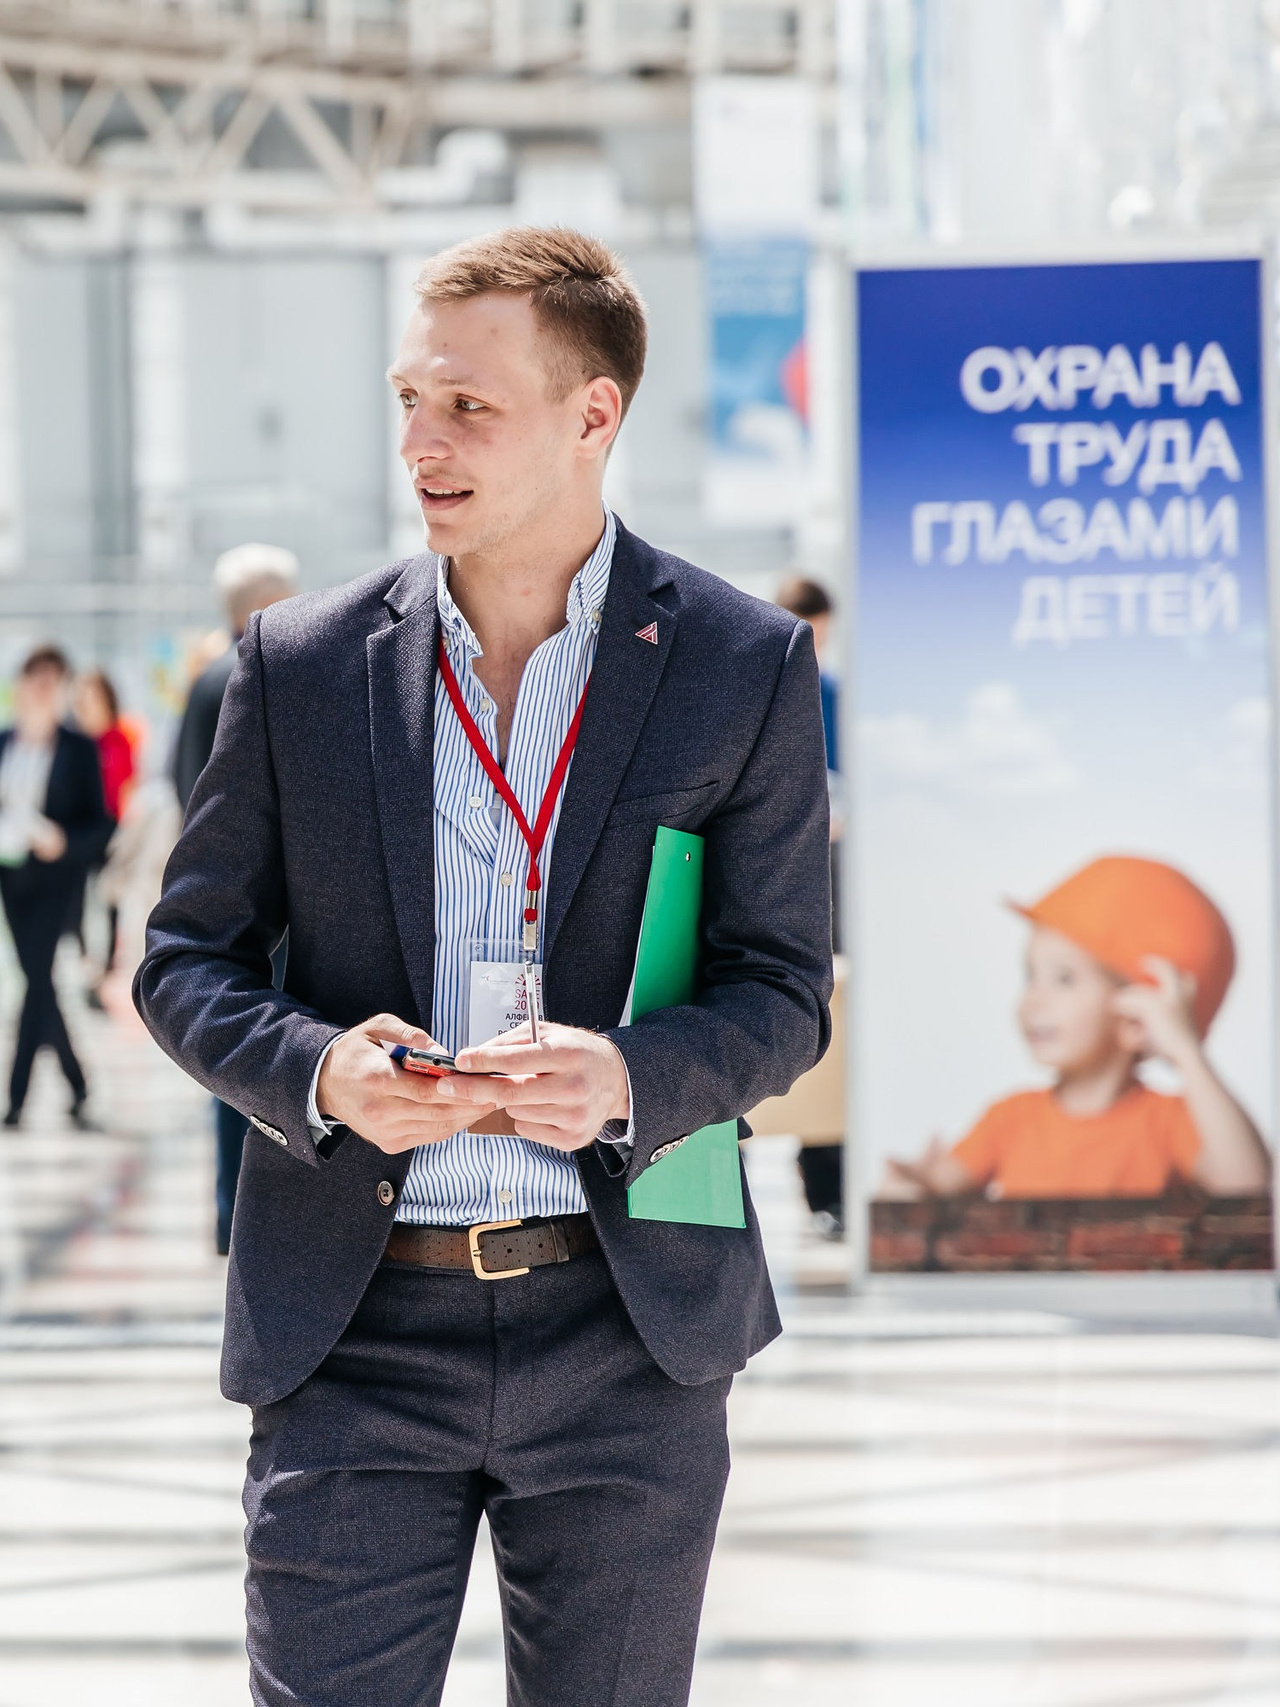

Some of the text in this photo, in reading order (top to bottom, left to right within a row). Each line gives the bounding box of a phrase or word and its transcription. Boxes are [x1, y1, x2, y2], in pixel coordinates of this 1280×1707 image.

[961, 342, 1241, 413] ОХРАНА
[1012, 418, 1241, 495] ТРУДА
[912, 496, 1238, 565] ГЛАЗАМИ
[1010, 562, 1238, 649] ДЕТЕЙ
[505, 1013, 543, 1021] АЛФЕВ
[515, 989, 540, 1000] SAE
[515, 1000, 540, 1011] 20
